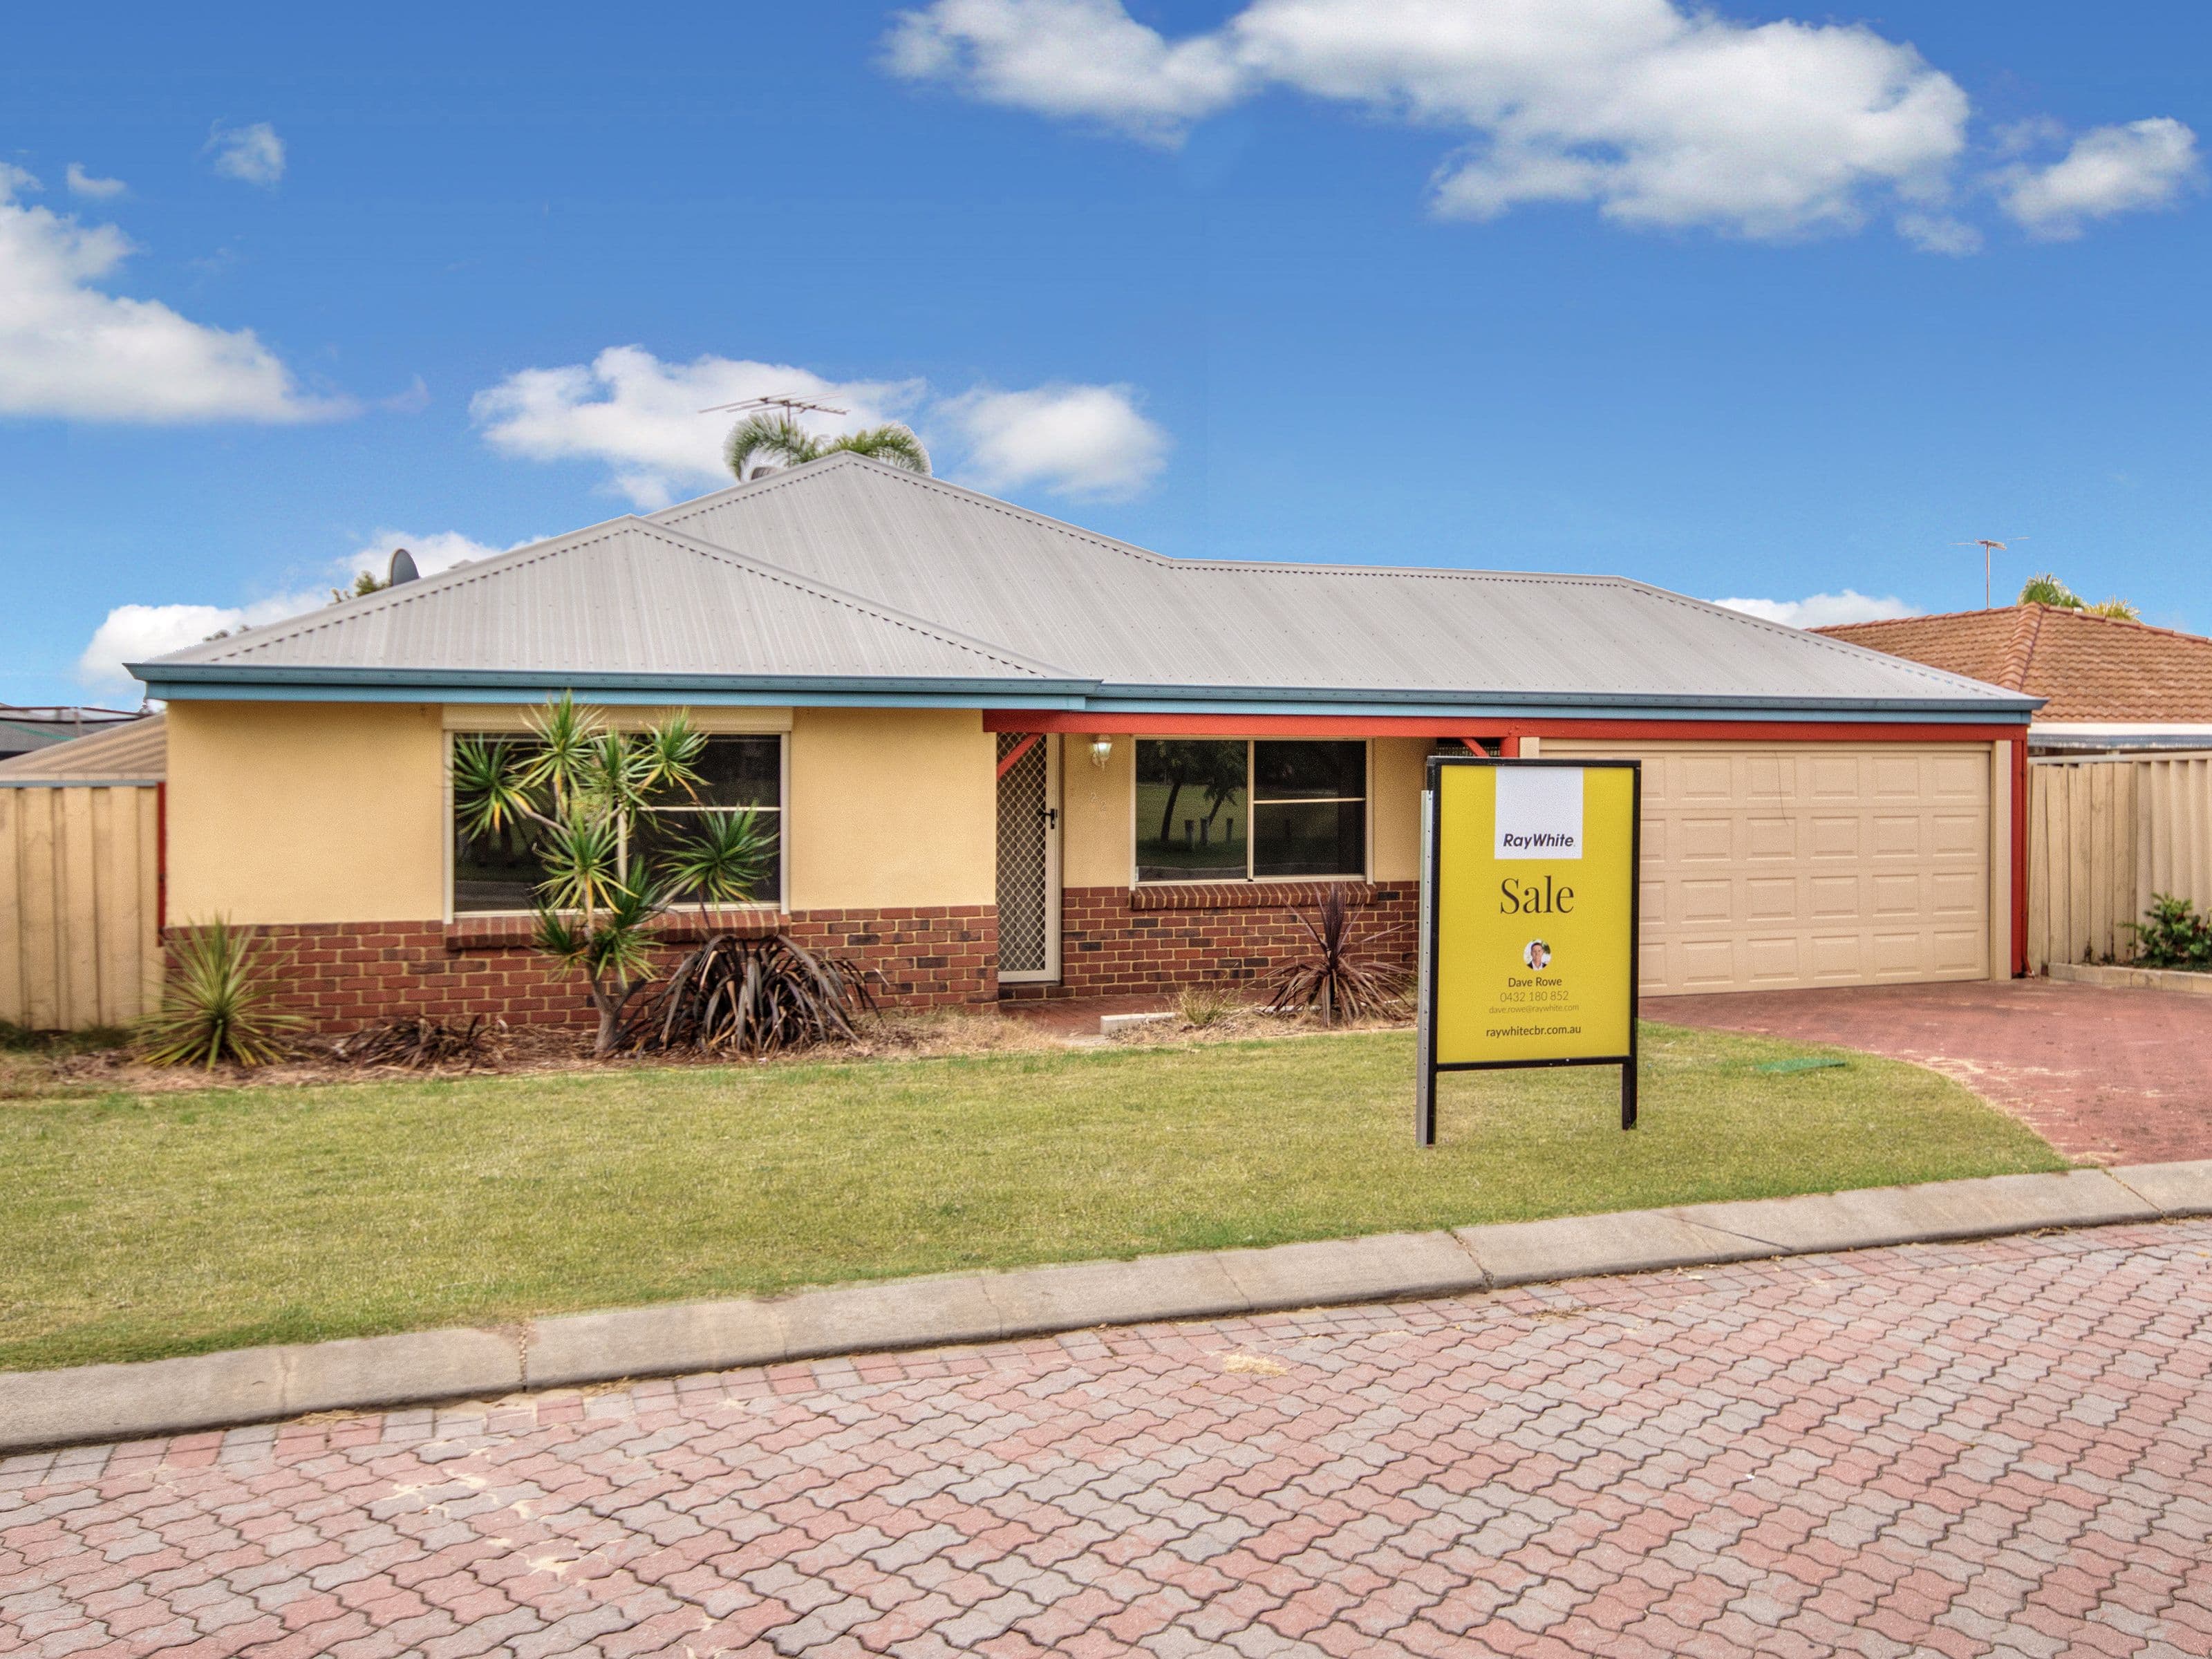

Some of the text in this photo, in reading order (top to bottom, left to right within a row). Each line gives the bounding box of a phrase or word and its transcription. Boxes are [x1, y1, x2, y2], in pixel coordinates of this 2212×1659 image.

[1500, 874, 1575, 915] Sale
[1508, 977, 1563, 988] Dave Rowe
[1500, 990, 1569, 1002] 0432 180 852
[1489, 1003, 1580, 1014] dave.rowe@raywhite.com
[1486, 1024, 1582, 1038] raywhitecbr.com.au
